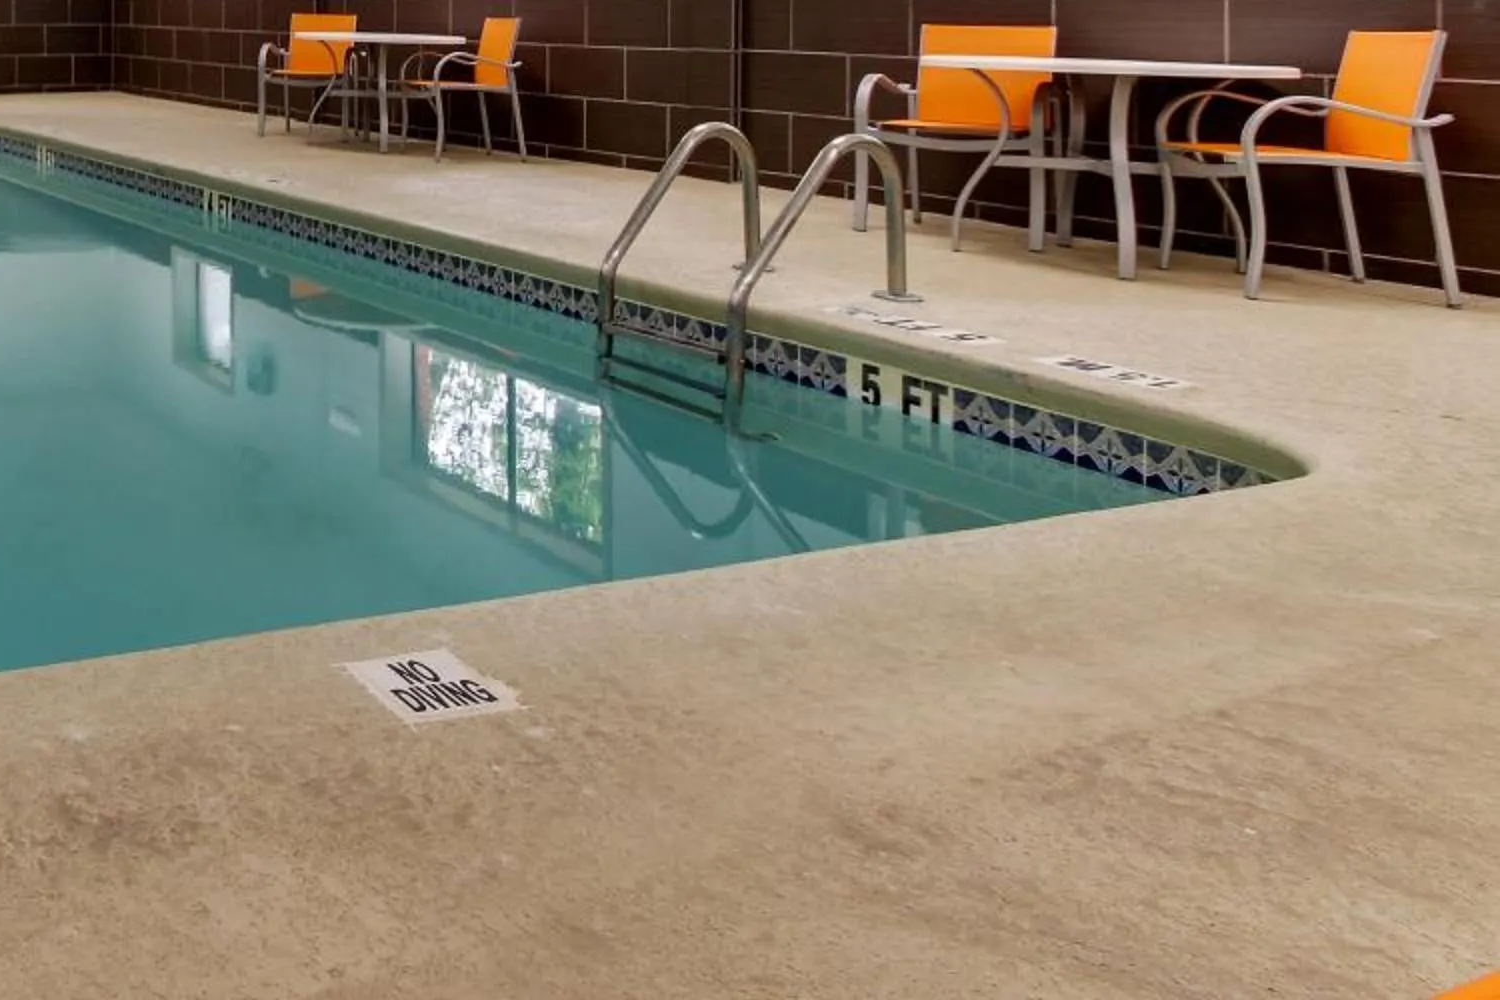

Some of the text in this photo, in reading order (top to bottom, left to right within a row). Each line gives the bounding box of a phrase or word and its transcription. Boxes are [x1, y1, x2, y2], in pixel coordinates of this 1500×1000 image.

[861, 363, 949, 425] 5 FT
[386, 659, 441, 686] NO
[390, 679, 499, 713] DIVING
